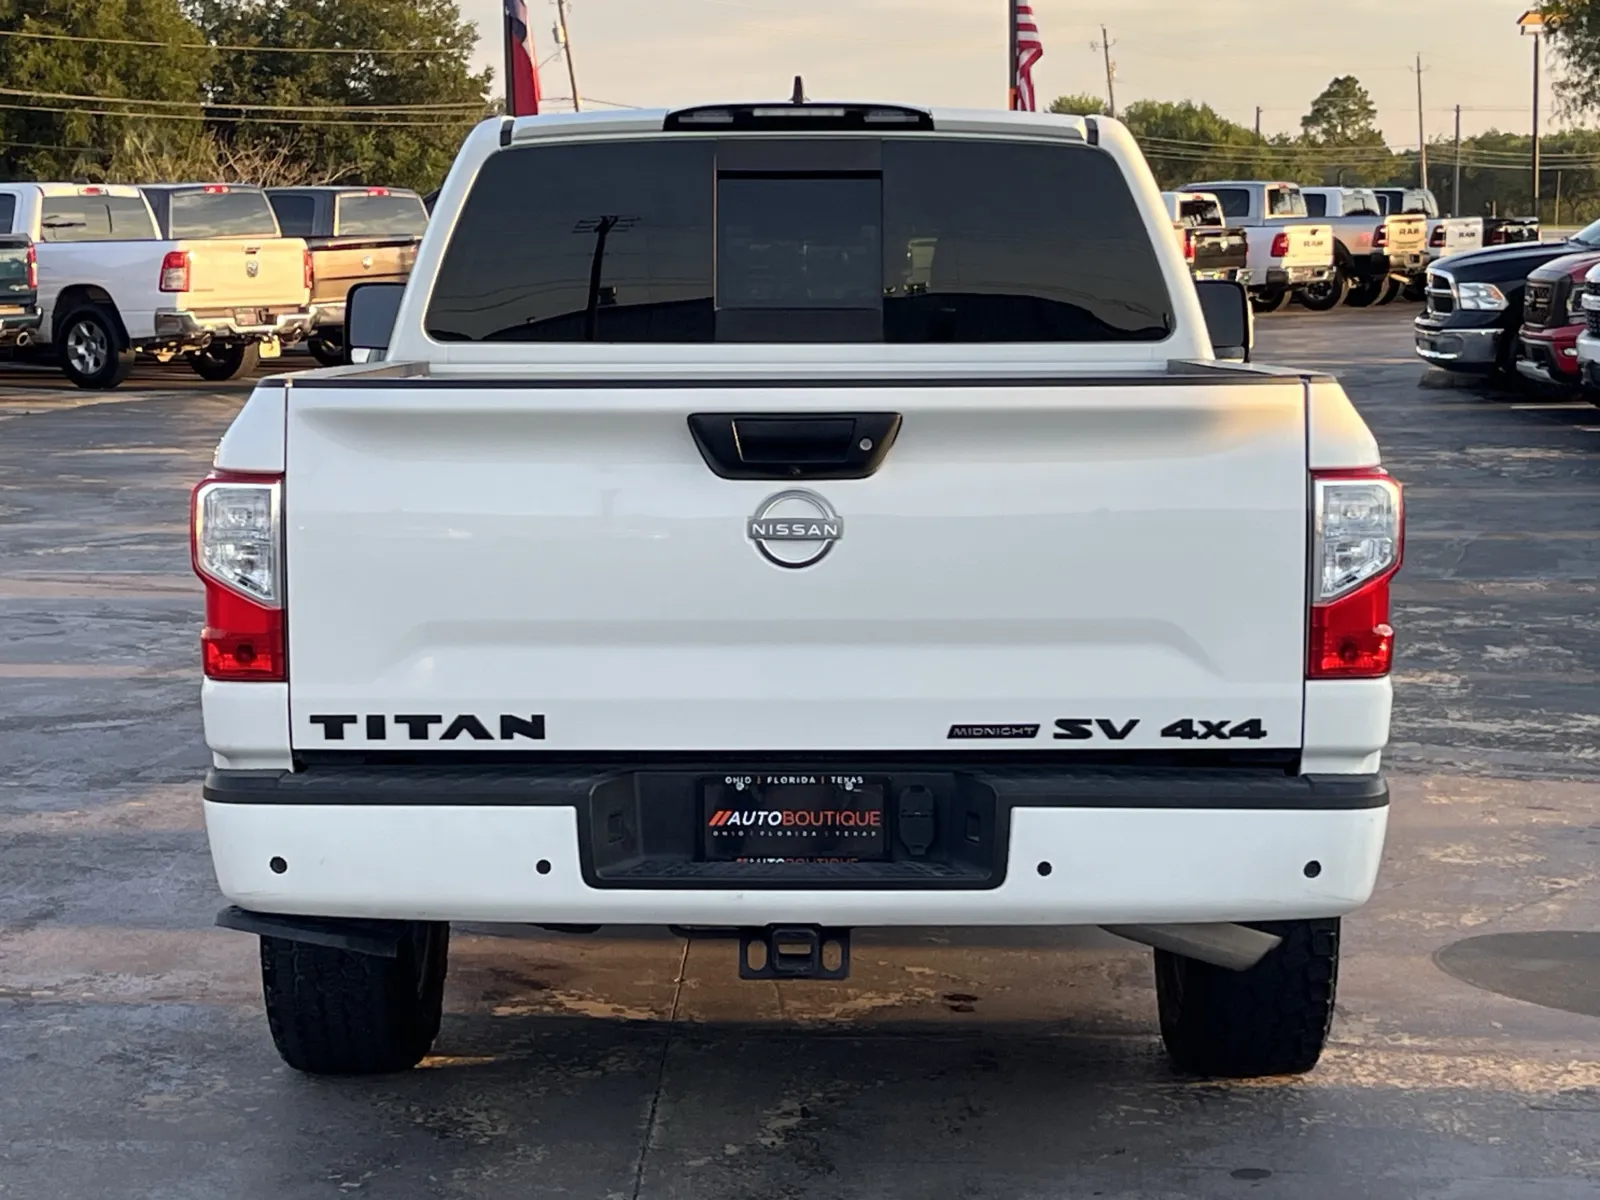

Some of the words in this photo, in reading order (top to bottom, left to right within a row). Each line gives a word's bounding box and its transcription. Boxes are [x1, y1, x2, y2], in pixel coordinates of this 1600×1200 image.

[752, 523, 838, 536] NISSAN
[309, 714, 546, 740] TITAN
[952, 726, 1035, 736] MIDNIGHT
[1053, 718, 1140, 740] SV
[725, 776, 752, 784] OHIO
[767, 776, 816, 784] FLORIDA
[830, 776, 864, 784] TEXAS
